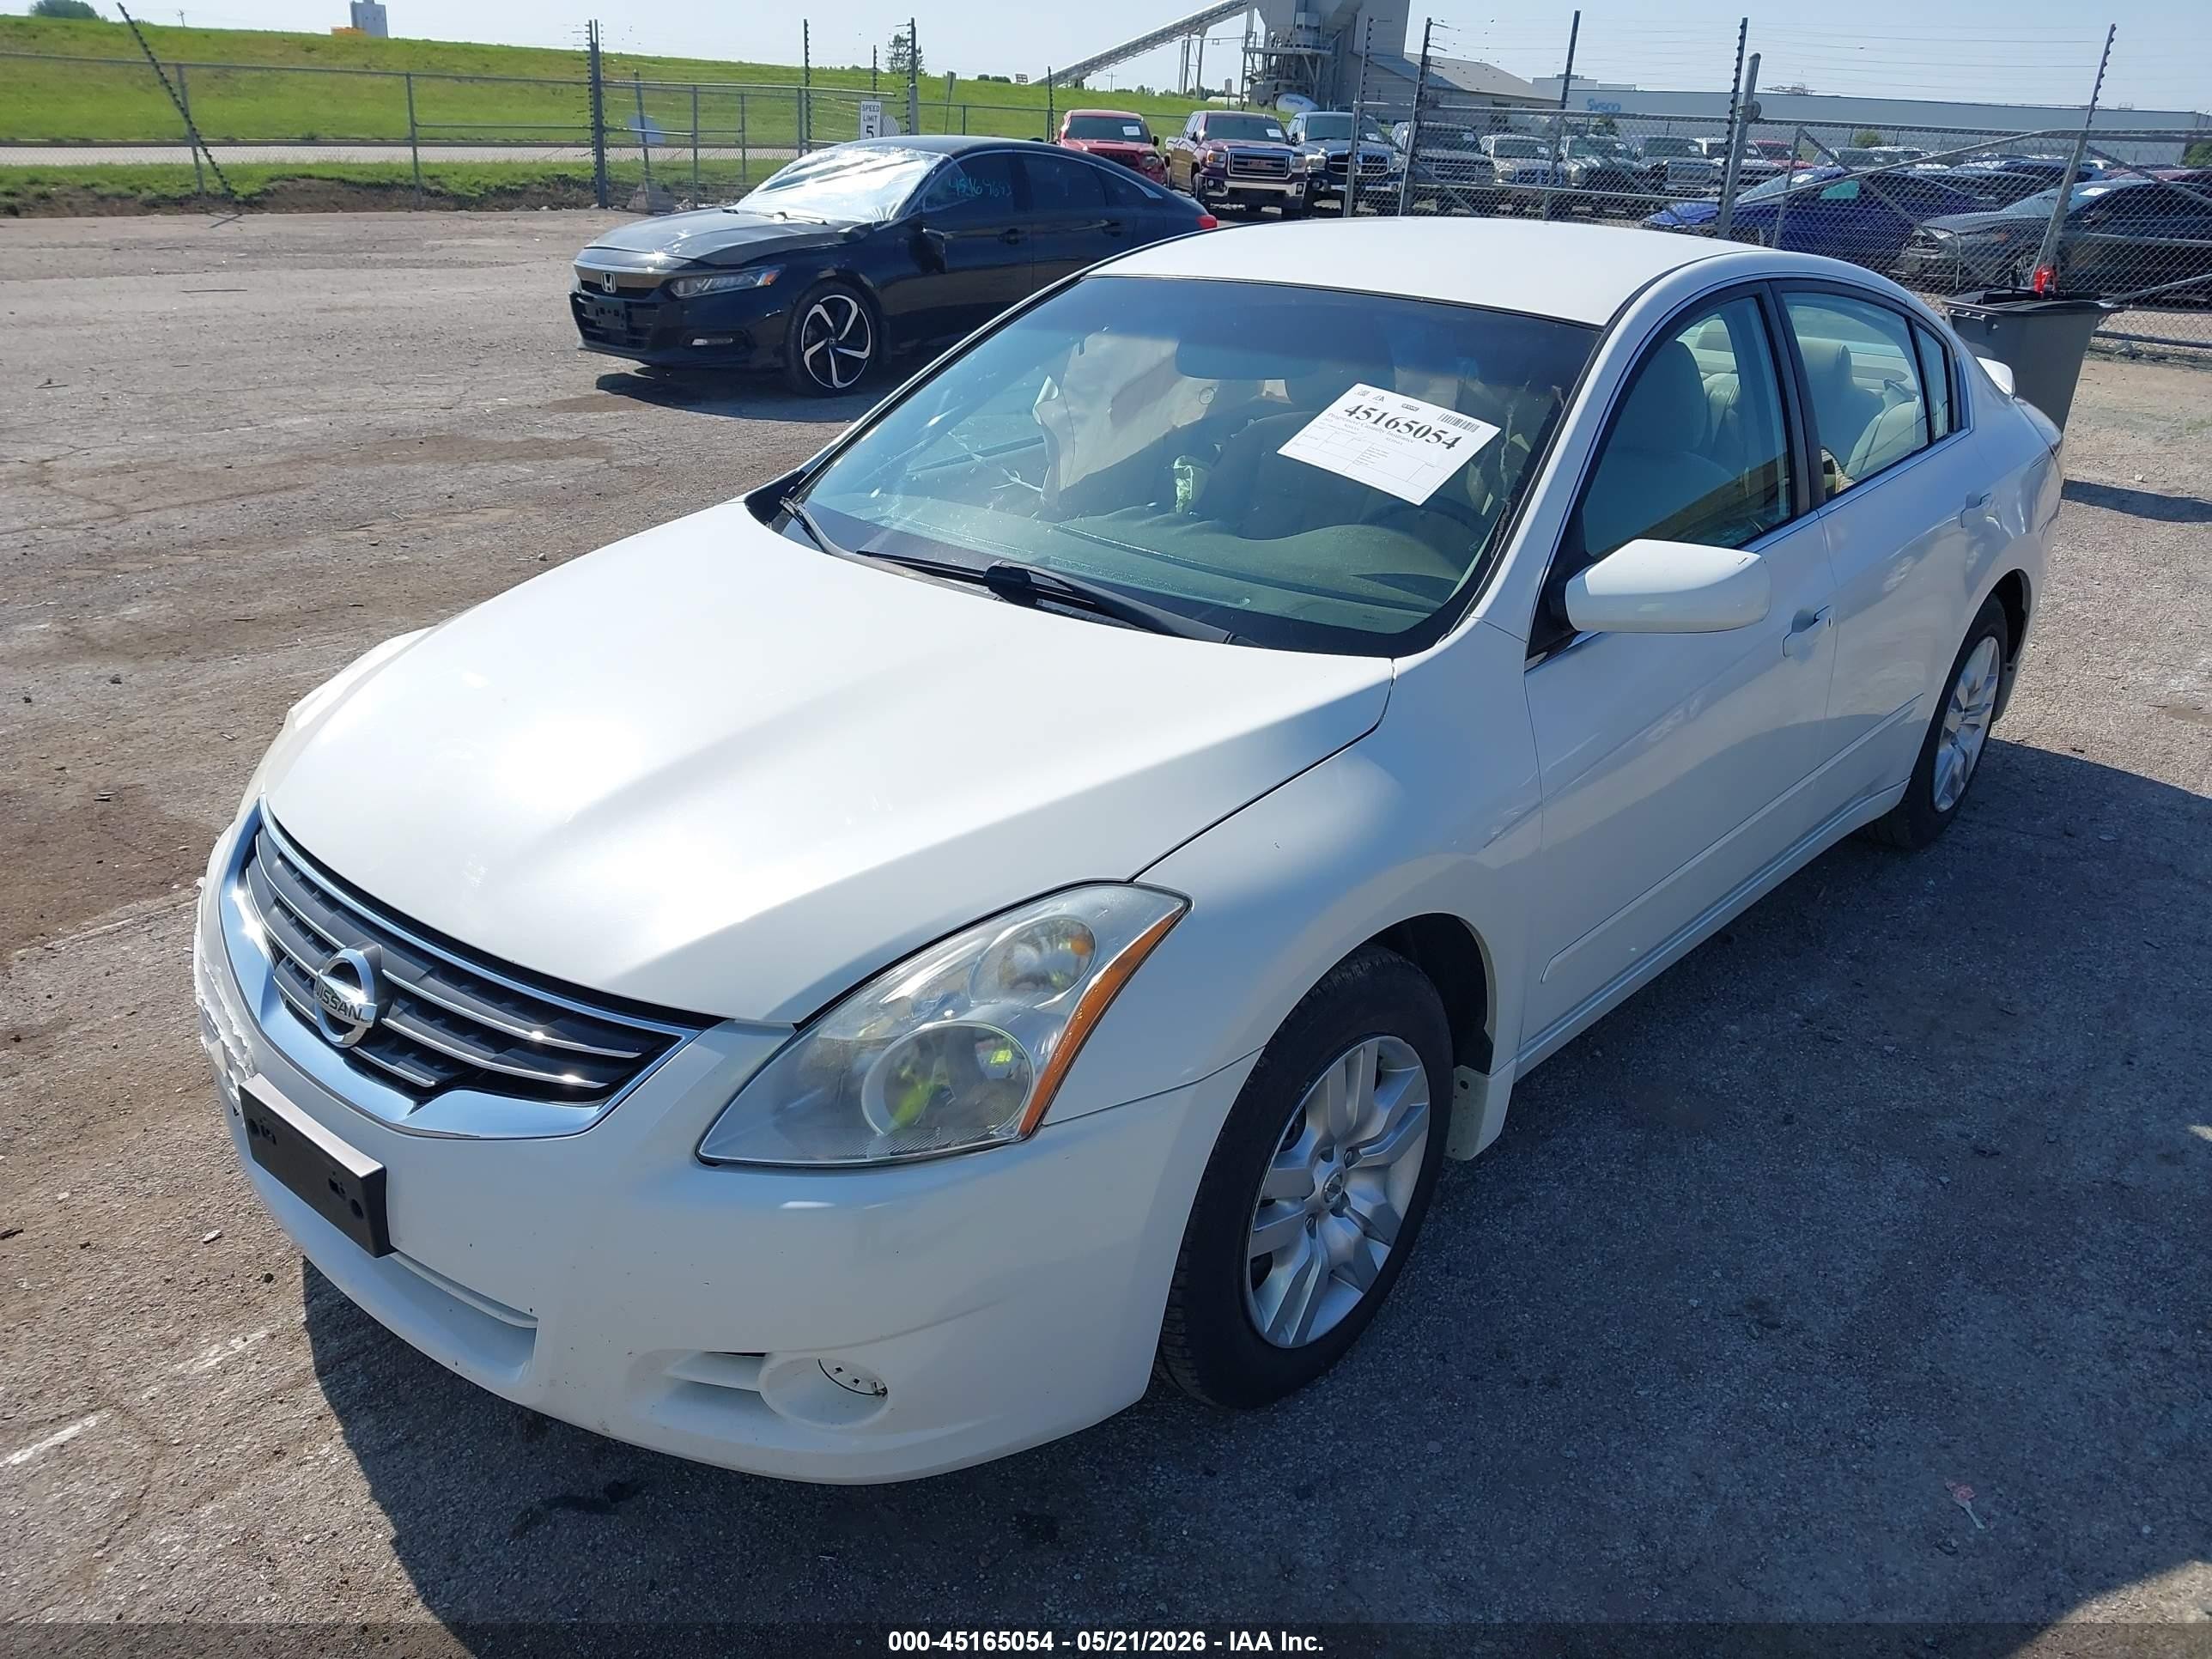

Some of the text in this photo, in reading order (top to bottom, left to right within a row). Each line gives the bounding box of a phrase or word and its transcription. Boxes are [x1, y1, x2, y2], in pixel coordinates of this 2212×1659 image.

[861, 103, 880, 112] SPEED
[866, 125, 874, 138] 5
[1345, 404, 1462, 450] 45165054
[315, 980, 362, 1021] NISSAN
